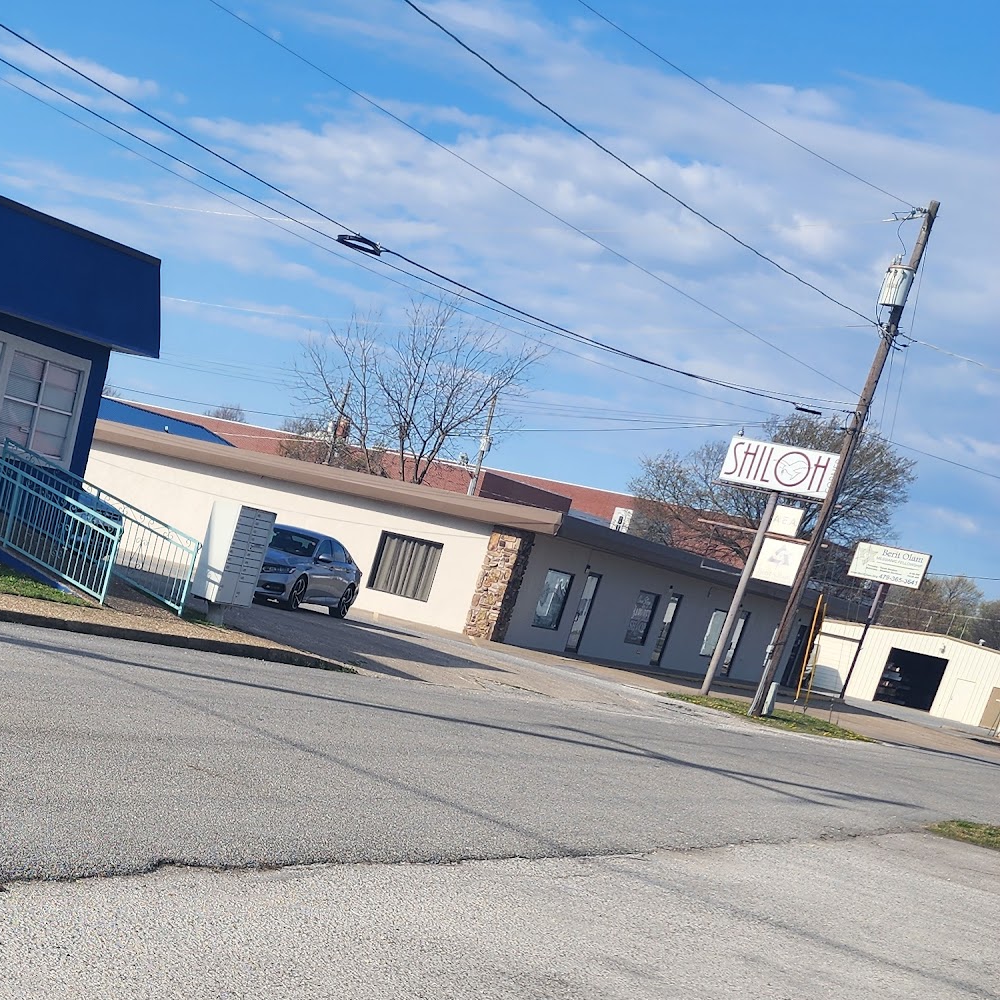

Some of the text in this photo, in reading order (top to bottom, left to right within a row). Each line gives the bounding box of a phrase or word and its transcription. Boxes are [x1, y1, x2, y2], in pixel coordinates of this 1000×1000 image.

[724, 441, 831, 492] SHILOH
[882, 549, 924, 564] Berit Olam
